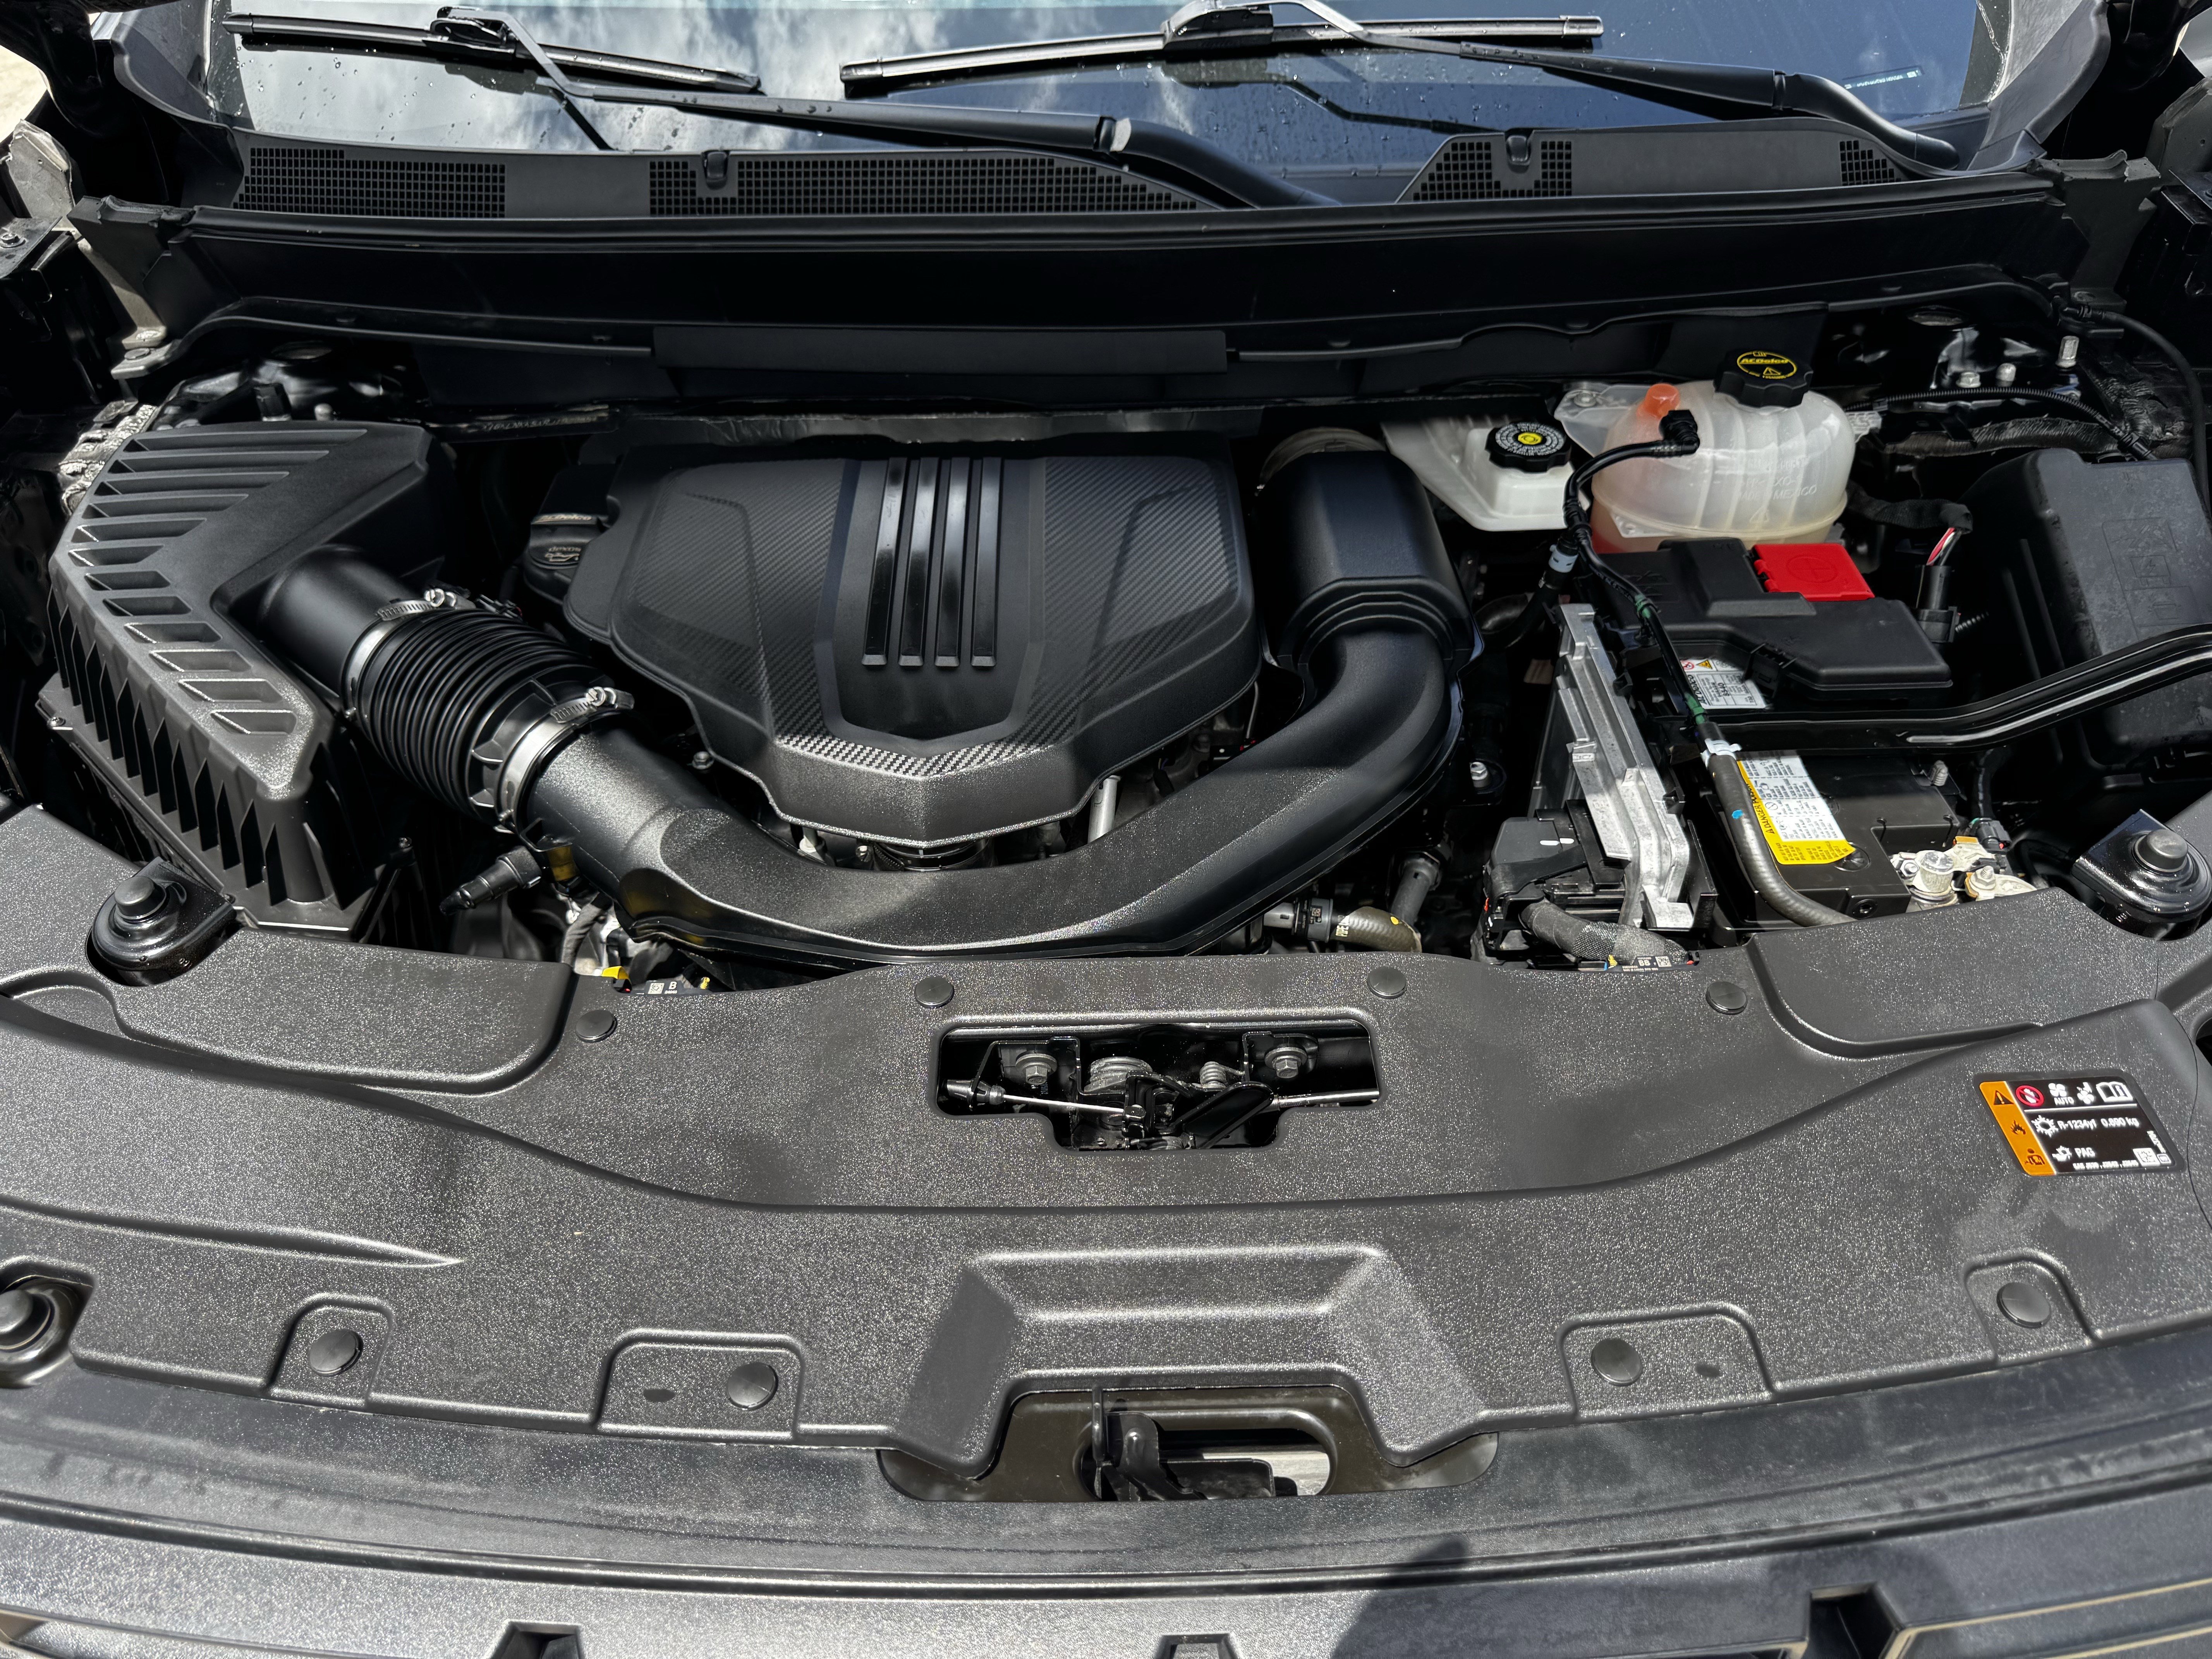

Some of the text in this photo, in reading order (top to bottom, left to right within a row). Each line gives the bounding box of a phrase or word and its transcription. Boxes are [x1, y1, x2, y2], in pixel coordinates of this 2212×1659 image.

[2054, 1097, 2075, 1106] AUTO
[2057, 1119, 2097, 1130] R-1234yf
[2125, 1117, 2140, 1127] kg
[2075, 1147, 2095, 1159] PAG
